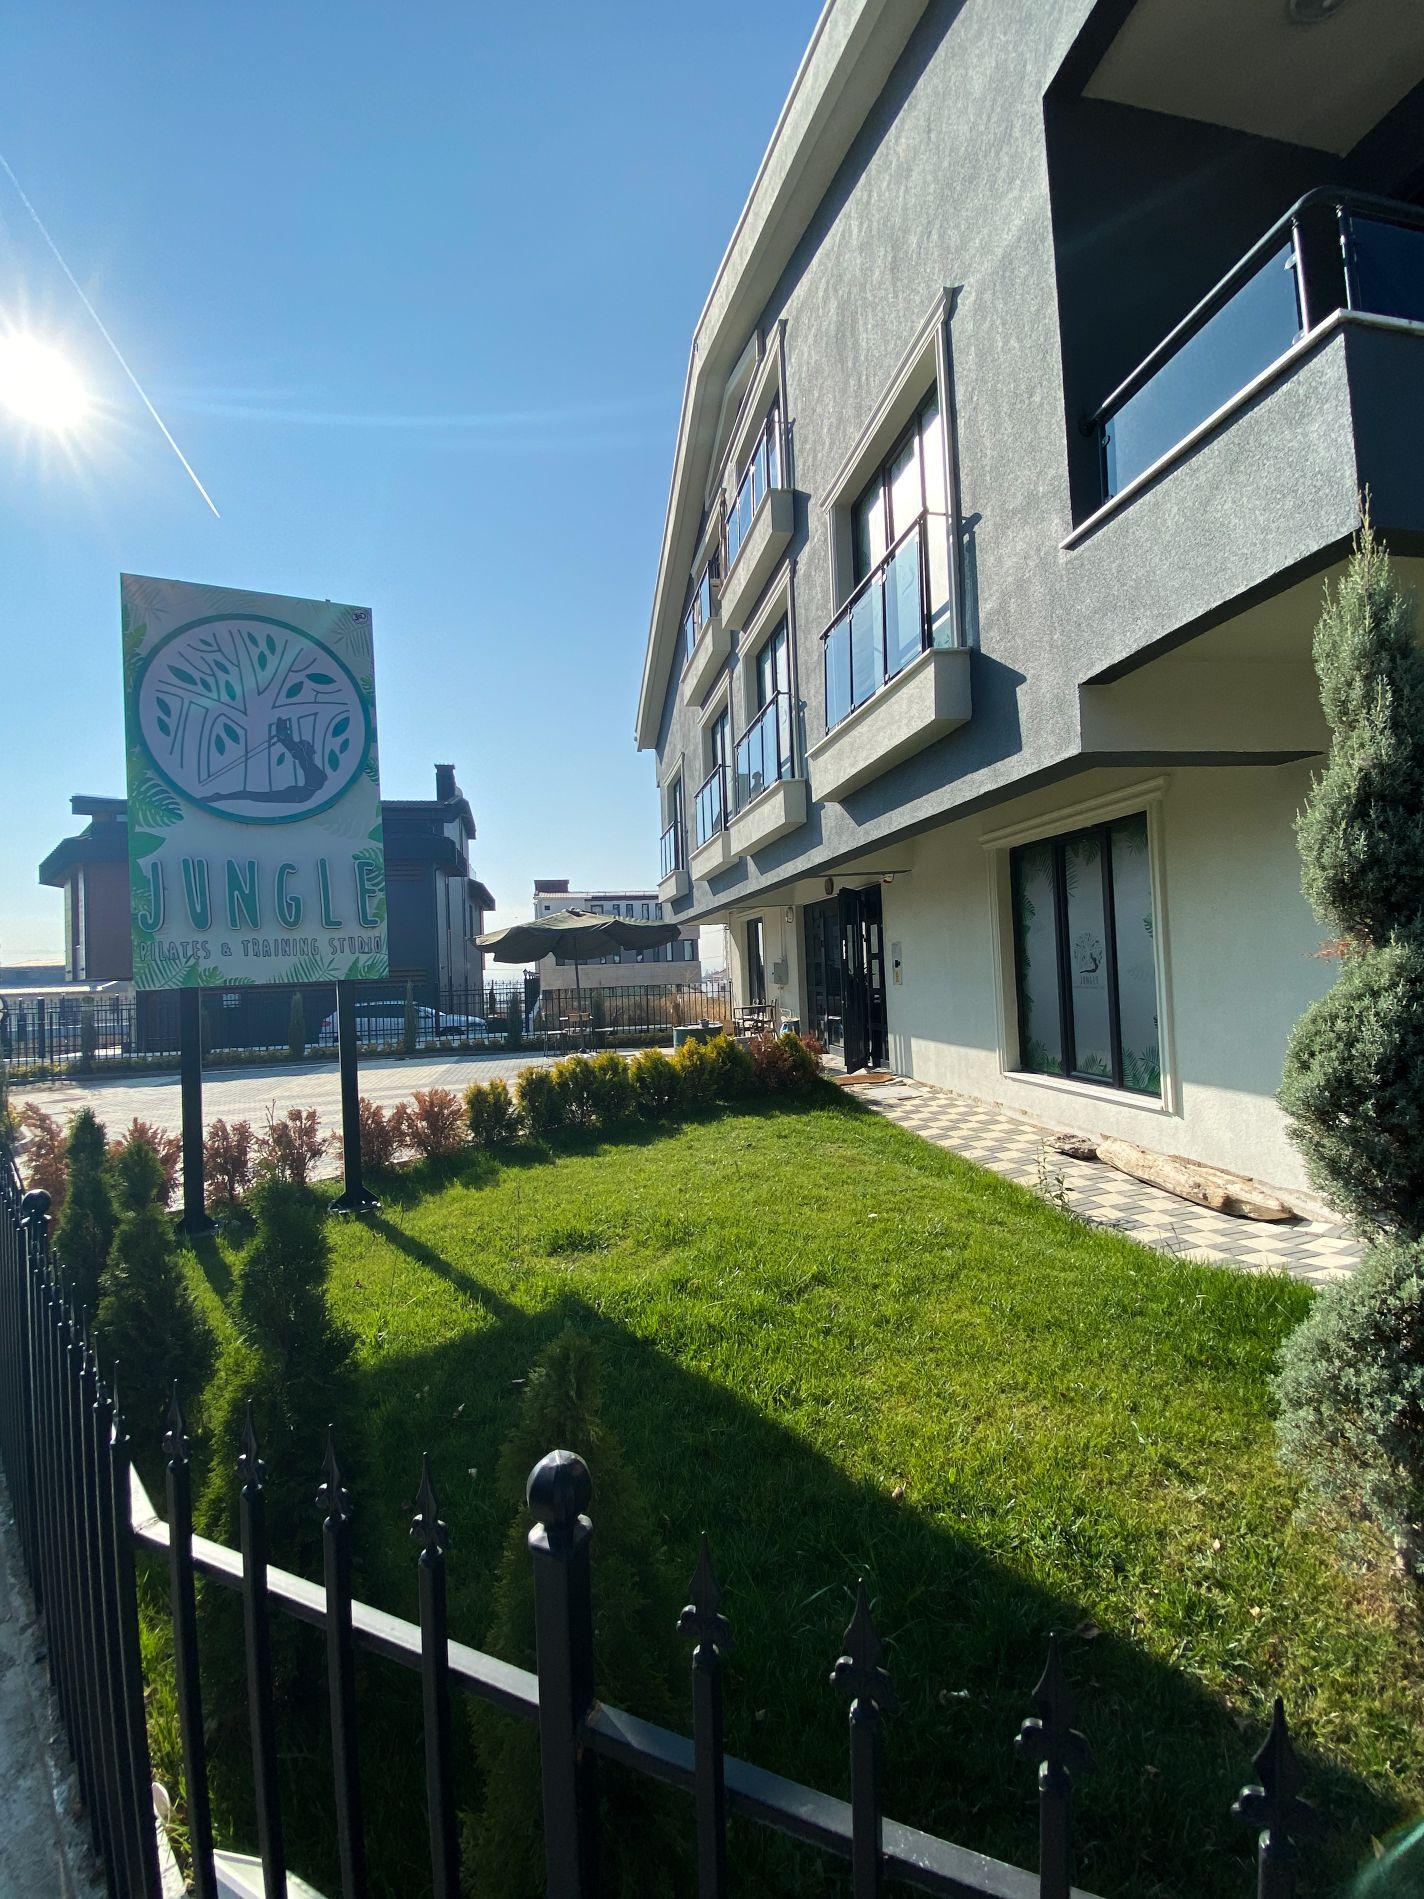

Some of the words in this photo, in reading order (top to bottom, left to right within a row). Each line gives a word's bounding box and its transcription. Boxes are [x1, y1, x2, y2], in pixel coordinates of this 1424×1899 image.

[138, 857, 381, 932] JUNGLE
[140, 940, 211, 960] PILATES
[221, 942, 233, 957] &
[241, 938, 319, 958] TRAINING
[328, 936, 381, 956] STUDIO
